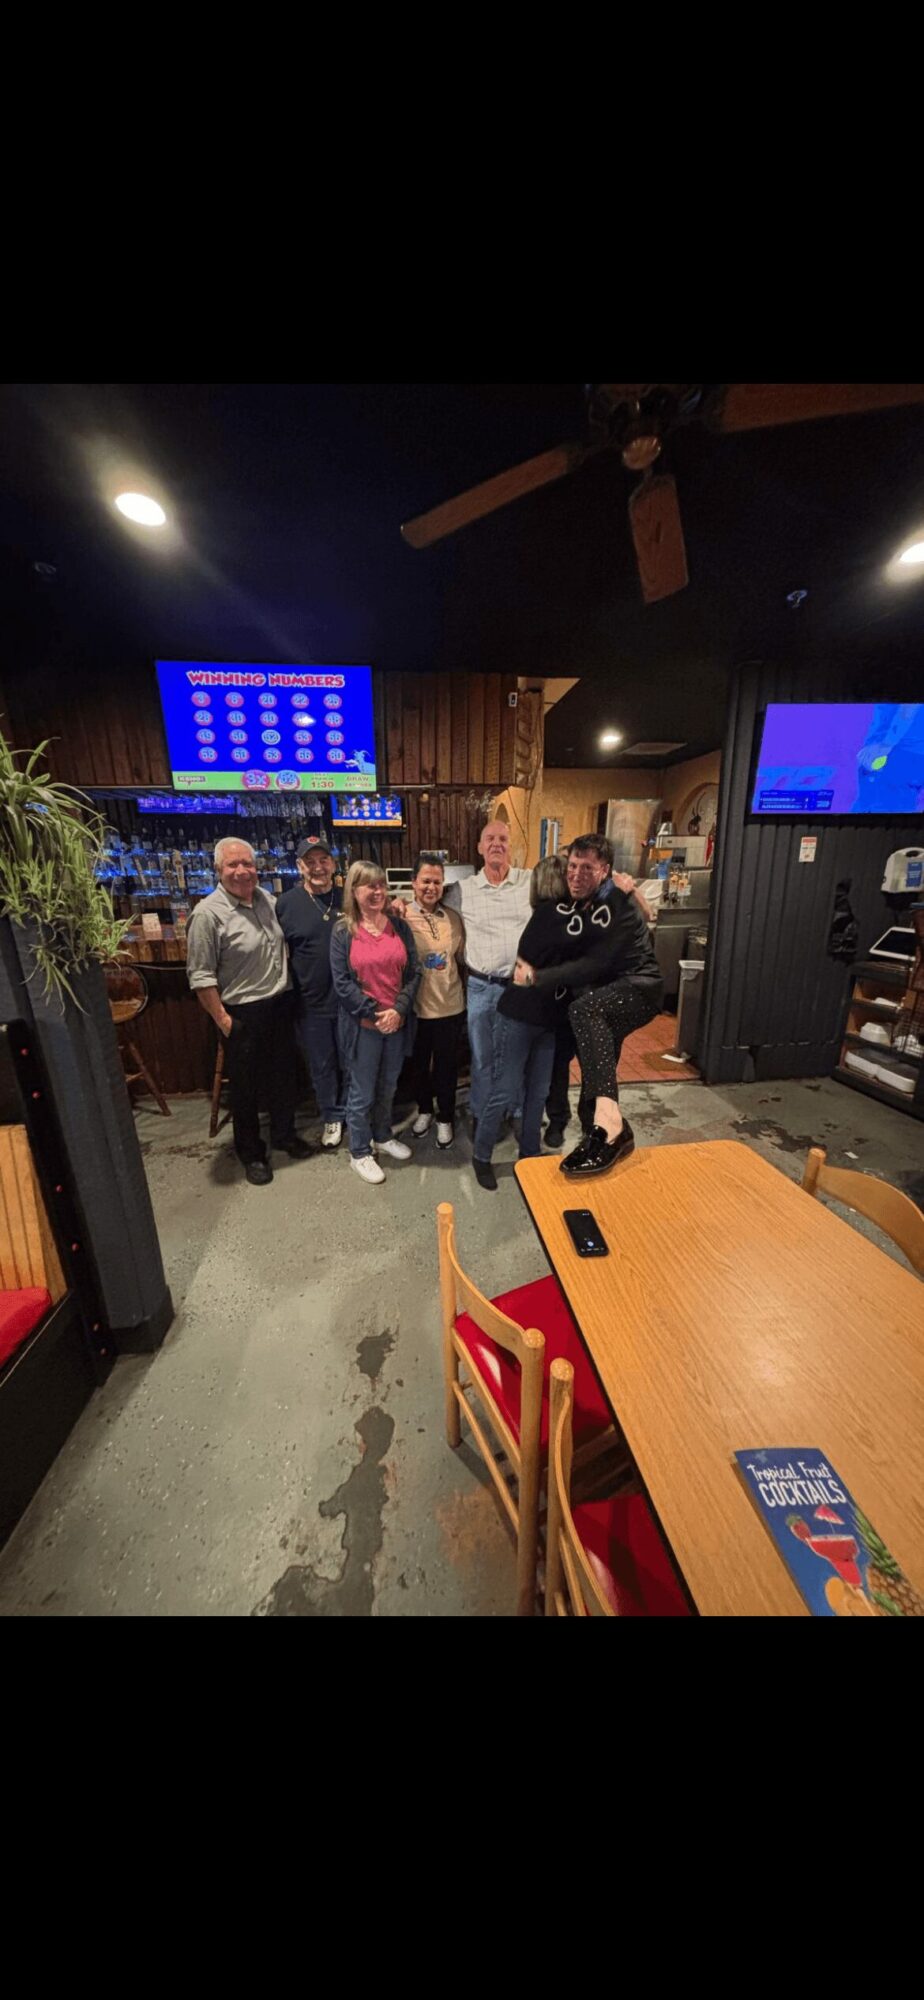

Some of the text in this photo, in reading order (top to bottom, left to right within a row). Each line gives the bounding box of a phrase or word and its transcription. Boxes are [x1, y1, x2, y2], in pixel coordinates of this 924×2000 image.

[186, 670, 345, 689] WINNING NUMBERS
[261, 695, 274, 705] 20
[294, 696, 307, 706] 22
[231, 713, 243, 723] 30
[263, 714, 276, 724] 40
[199, 731, 212, 741] 49
[232, 732, 245, 742] 50
[297, 733, 310, 742] 53
[234, 750, 247, 760] 60
[747, 1461, 833, 1483] Tropical Fruit
[758, 1479, 847, 1507] COCKTAILS
